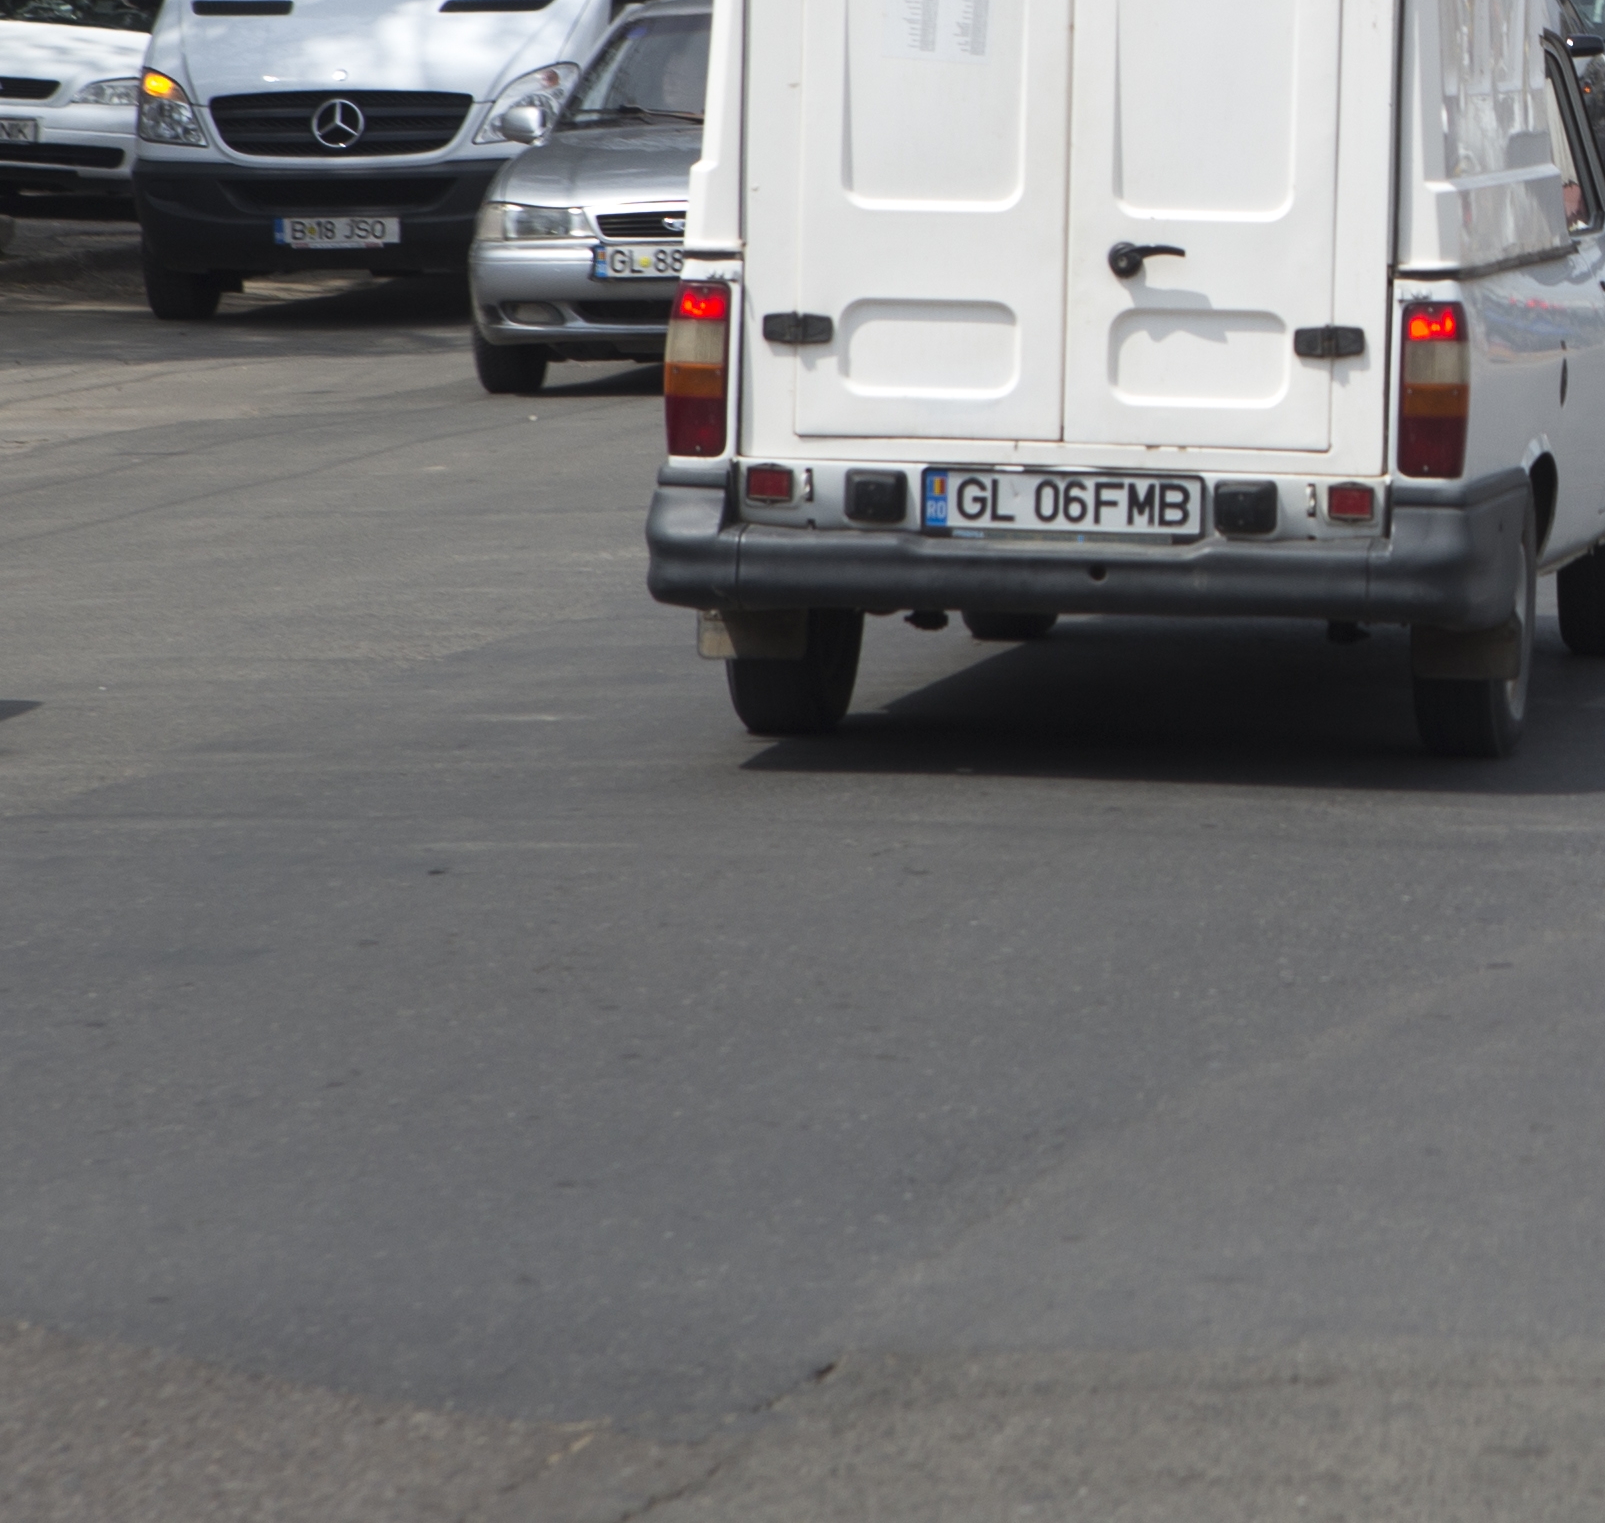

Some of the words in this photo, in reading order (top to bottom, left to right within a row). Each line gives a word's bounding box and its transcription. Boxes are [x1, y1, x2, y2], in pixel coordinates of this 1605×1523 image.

[291, 220, 307, 240] B
[315, 220, 336, 240] 18
[343, 219, 386, 240] JSO
[610, 249, 643, 273] GL
[653, 249, 683, 273] 88
[926, 500, 947, 519] RO
[955, 476, 1016, 522] GL
[1033, 478, 1191, 527] 06FMB
